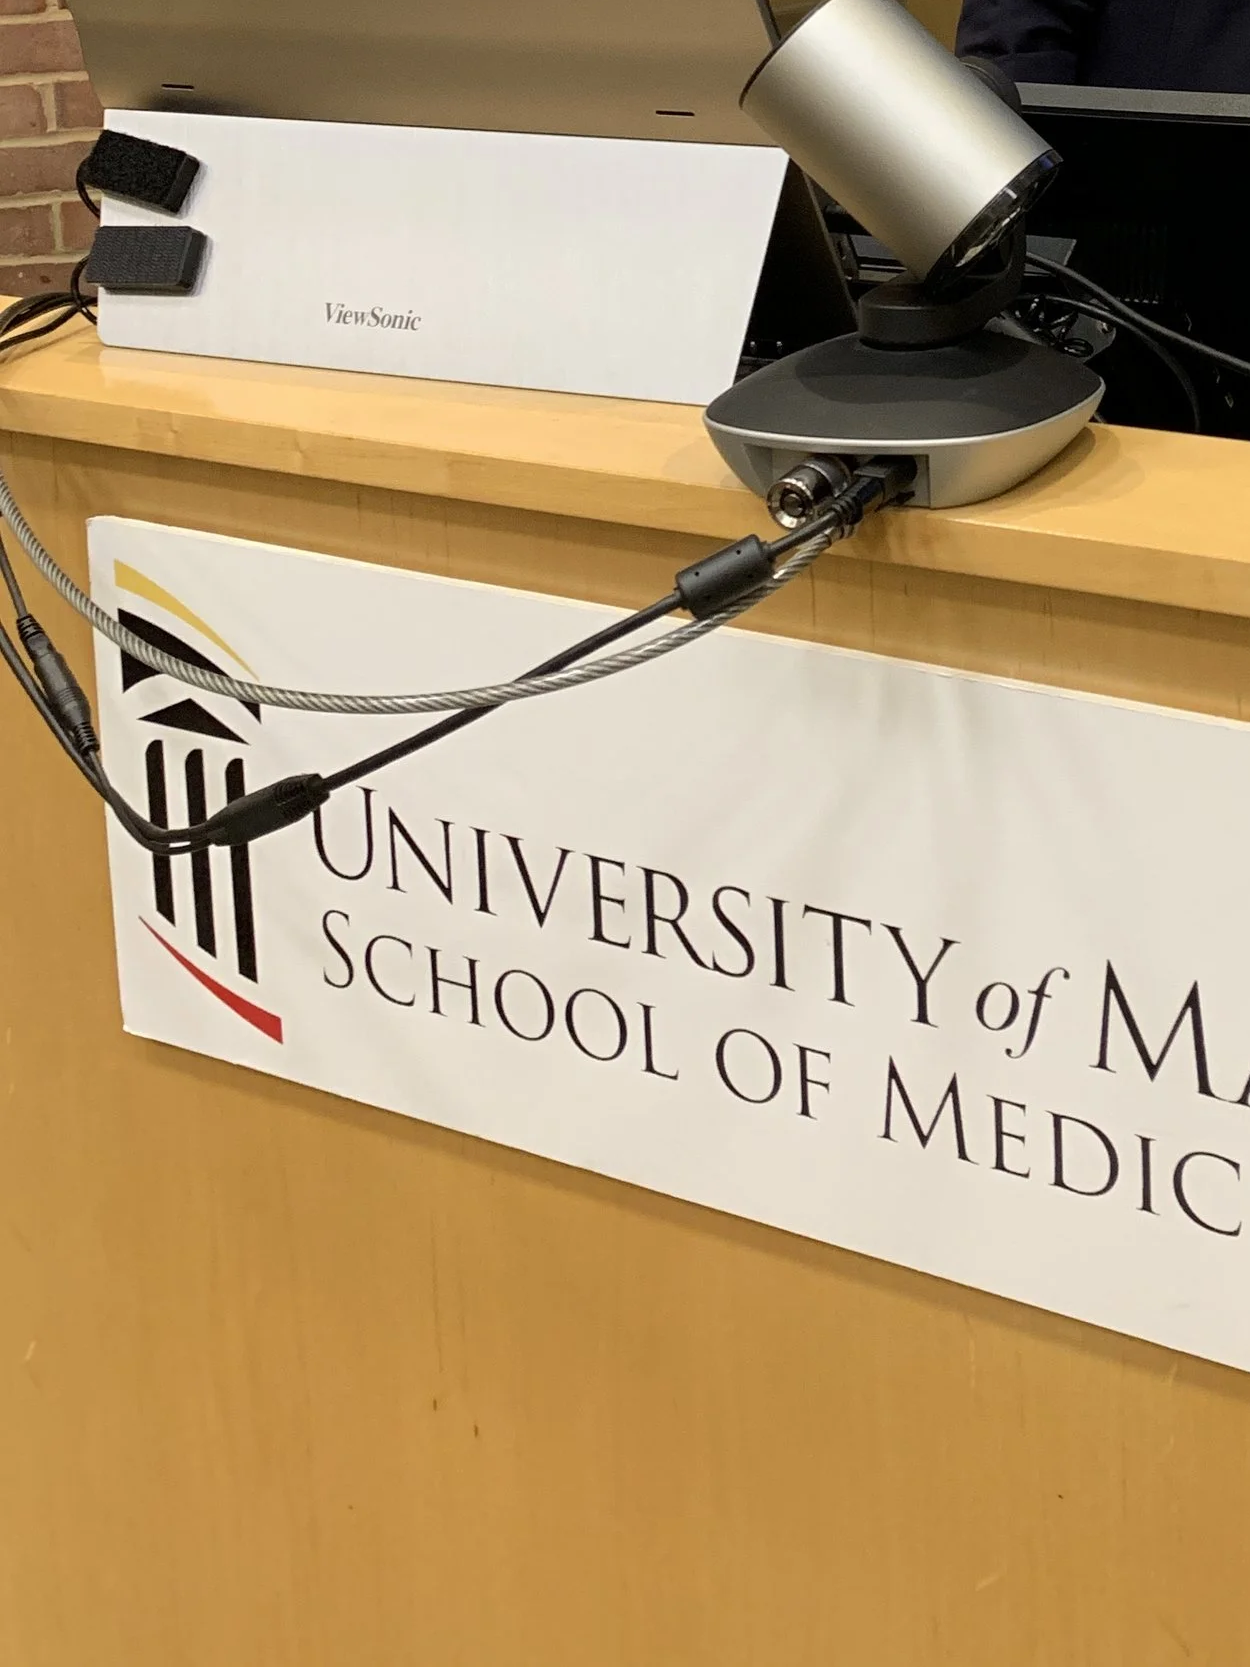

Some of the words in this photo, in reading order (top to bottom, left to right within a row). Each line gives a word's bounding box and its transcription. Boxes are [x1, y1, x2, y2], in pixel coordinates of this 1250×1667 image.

[325, 302, 422, 331] ViewSonic
[312, 785, 960, 1028] UNIVERSITY
[975, 966, 1070, 1060] of
[321, 908, 680, 1082] SCHOOL
[714, 1027, 833, 1120] OF
